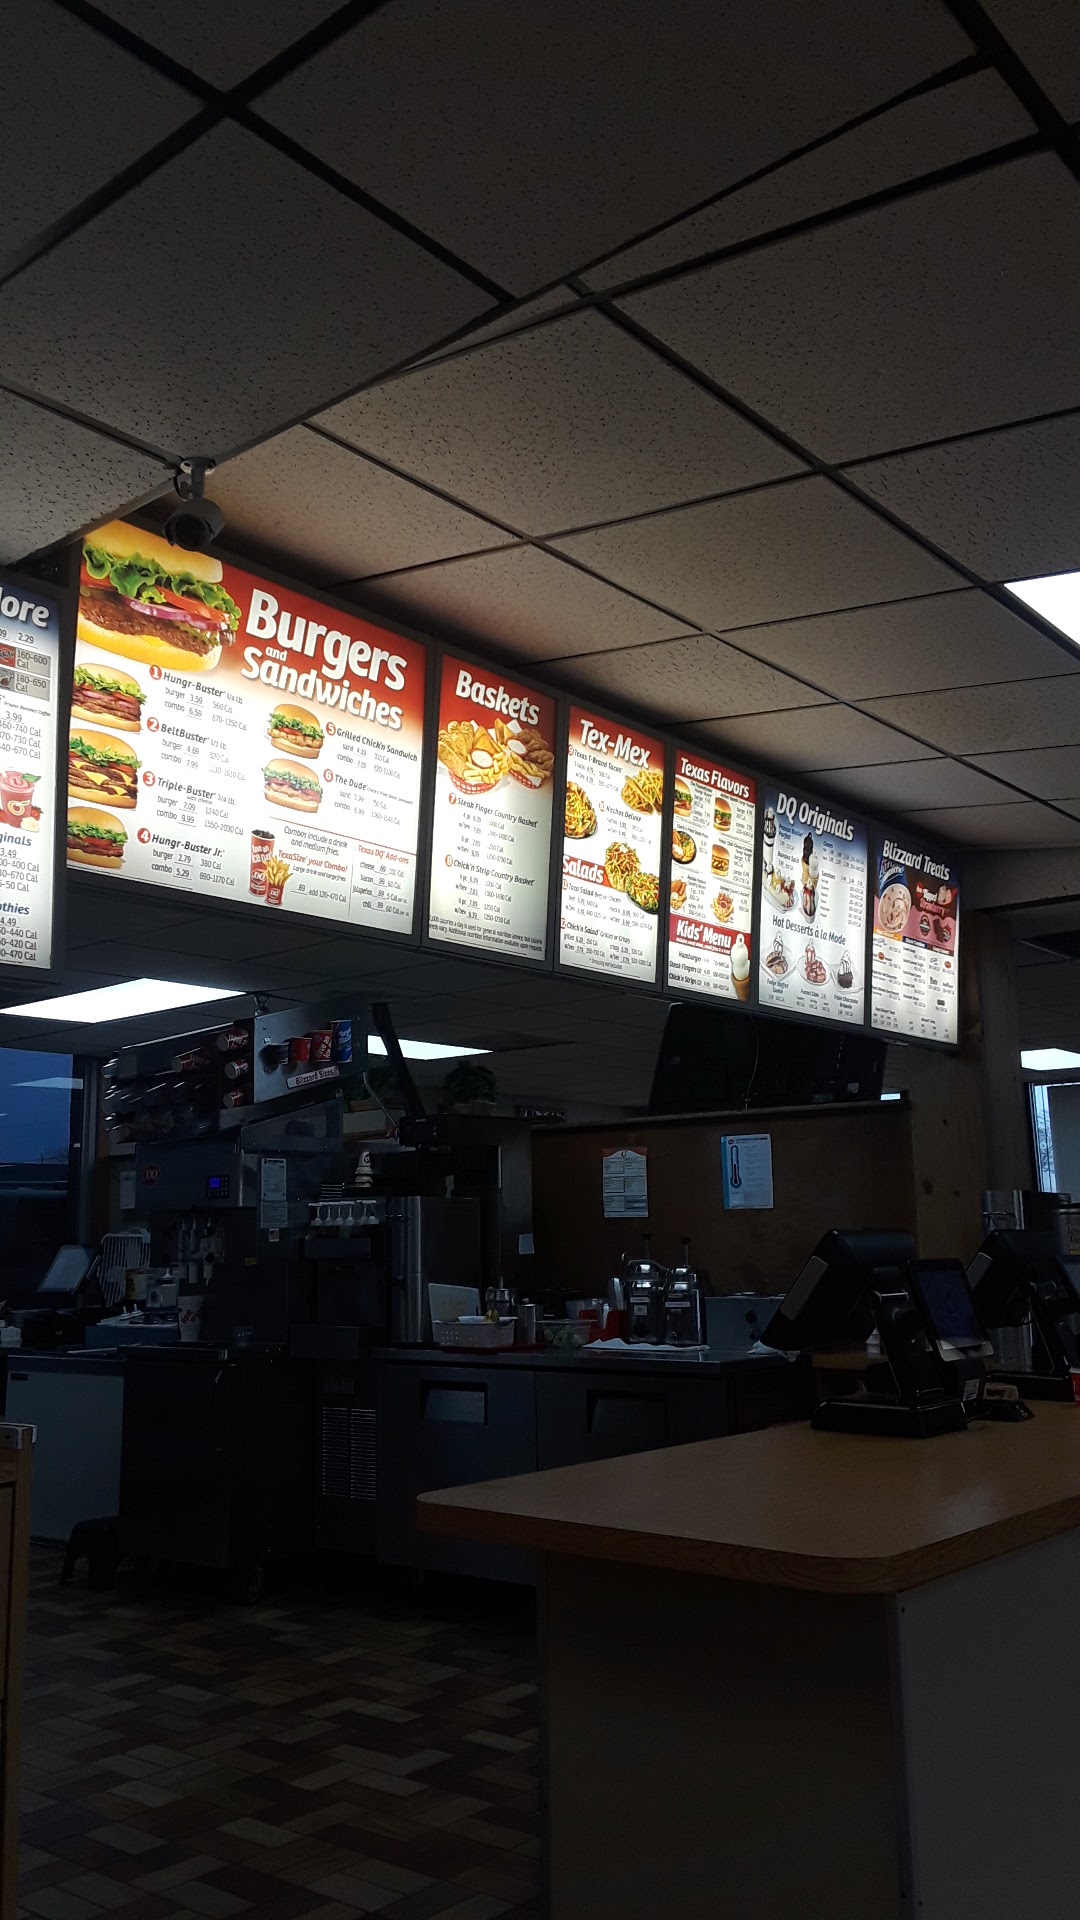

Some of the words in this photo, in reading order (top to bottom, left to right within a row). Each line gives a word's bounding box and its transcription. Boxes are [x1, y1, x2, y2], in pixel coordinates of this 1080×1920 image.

[18, 632, 34, 644] 2.29
[245, 588, 408, 691] Burgers
[17, 649, 48, 666] 160-600
[265, 646, 288, 662] and
[17, 659, 29, 670] Cal
[16, 673, 47, 689] 180-650
[16, 683, 28, 693] Cal
[163, 672, 223, 697] Hungr-Buster
[240, 646, 403, 730] Sandwiches
[165, 687, 185, 699] burger
[455, 669, 540, 725] Baskets
[165, 700, 185, 712] combo
[30, 726, 41, 737] Cal
[161, 724, 207, 744] BeltBuster
[29, 737, 41, 748] Cal
[337, 728, 361, 742] Grilled
[362, 737, 385, 751] Chick'n
[387, 744, 417, 761] Sandwich
[580, 719, 651, 768] Tex-Mex
[29, 748, 41, 759] Cal
[335, 774, 348, 785] The
[349, 779, 366, 791] Dude
[681, 757, 710, 783] Texas
[711, 769, 750, 798] Flavors
[158, 777, 214, 799] Triple-Buster
[158, 796, 178, 807] burger
[157, 809, 177, 820] combo
[495, 810, 517, 823] Country
[777, 792, 797, 825] DQ
[799, 802, 855, 841] Originals
[139, 829, 150, 842] 4
[152, 834, 212, 854] Hungr-Buster
[27, 862, 39, 873] Cal
[153, 849, 173, 860] burger
[178, 853, 191, 863] 2.79
[213, 861, 221, 870] Cal
[324, 860, 348, 873] Combo!
[883, 840, 923, 870] Blizzard
[923, 855, 951, 881] Treats
[152, 863, 172, 873] combo
[176, 869, 189, 877] 5.29
[226, 876, 235, 886] Cal
[476, 865, 490, 876] Strip
[491, 869, 513, 883] Country
[563, 855, 604, 884] Salads
[26, 873, 38, 883] Cal
[17, 882, 29, 892] Cal
[26, 930, 38, 940] Cal
[584, 926, 598, 936] Salad
[677, 920, 703, 941] Kids'
[703, 927, 732, 948] Menu
[773, 915, 784, 928] Hot
[786, 920, 813, 936] Desserts
[829, 931, 846, 945] Mode
[25, 940, 37, 950] Cal
[24, 952, 36, 961] Cal
